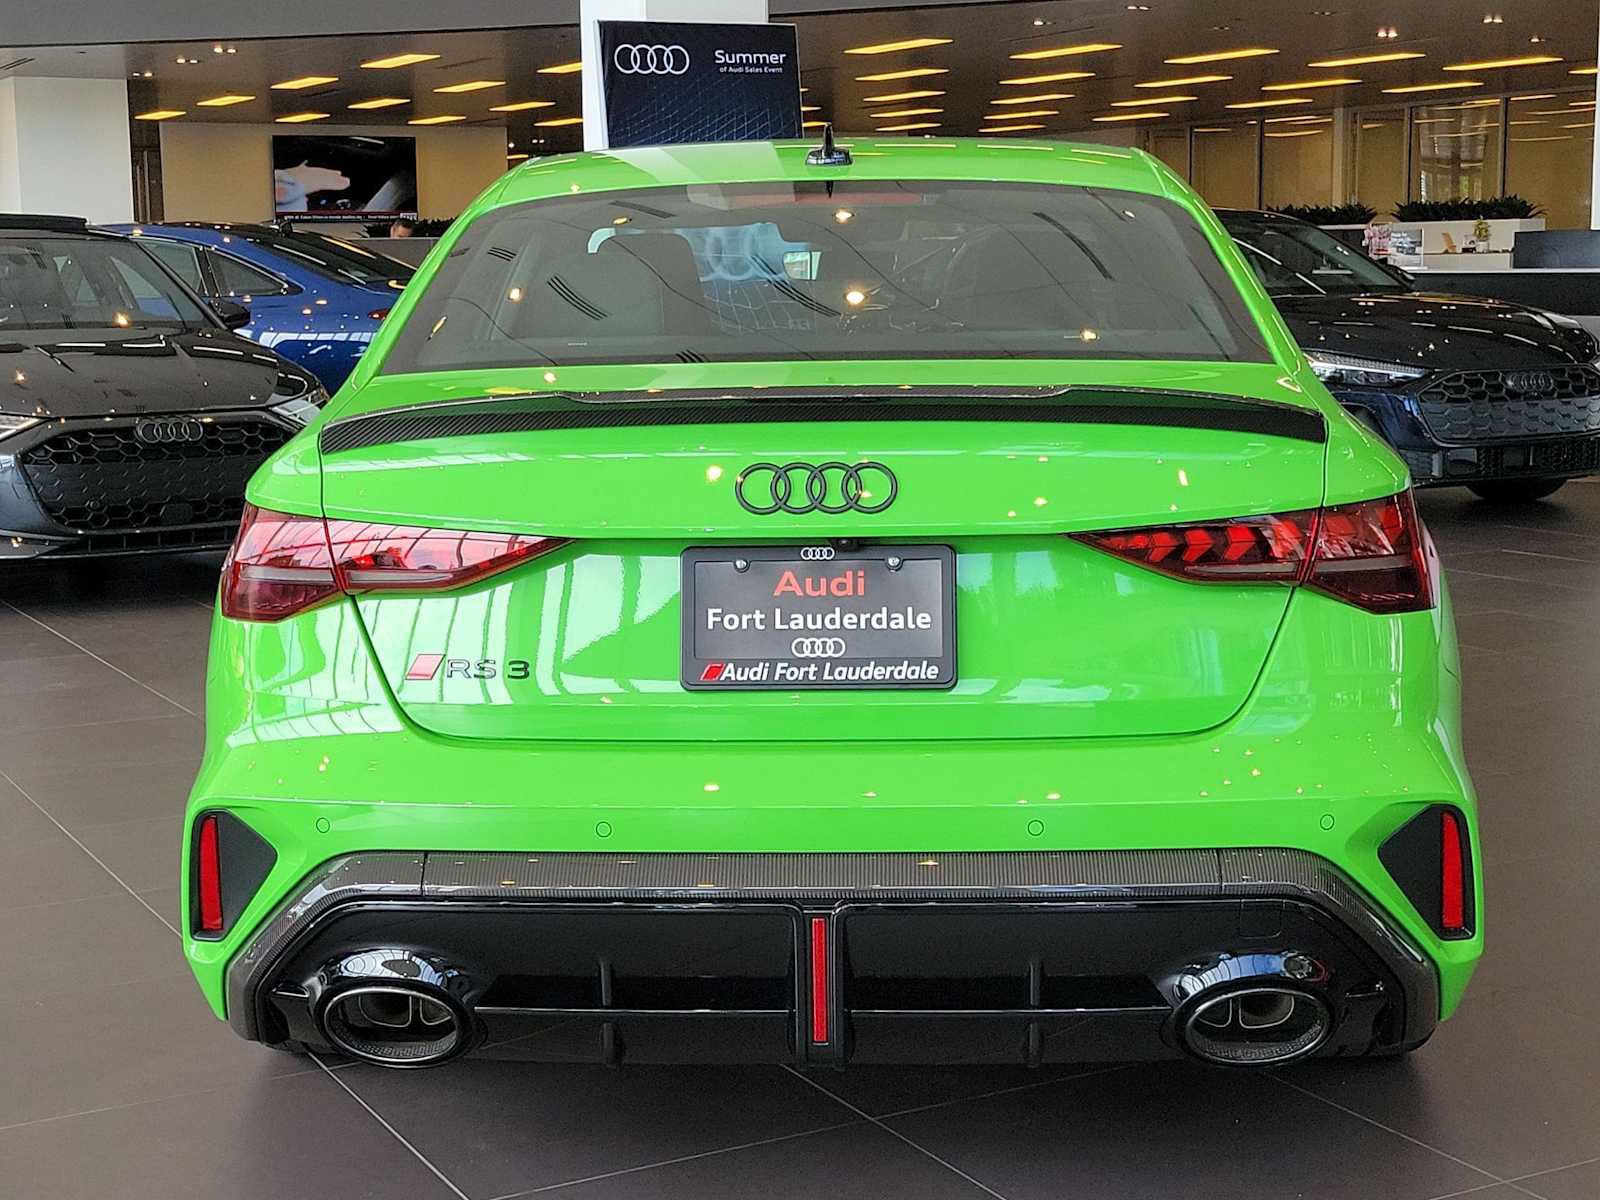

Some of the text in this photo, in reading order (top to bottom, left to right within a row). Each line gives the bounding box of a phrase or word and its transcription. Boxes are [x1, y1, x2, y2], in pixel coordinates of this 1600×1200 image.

[715, 49, 787, 64] Summer
[773, 570, 865, 597] Audi
[707, 607, 932, 630] Fort Lauderdale
[446, 658, 530, 680] RS 3
[720, 661, 939, 681] Audi Fort Lauderdale
